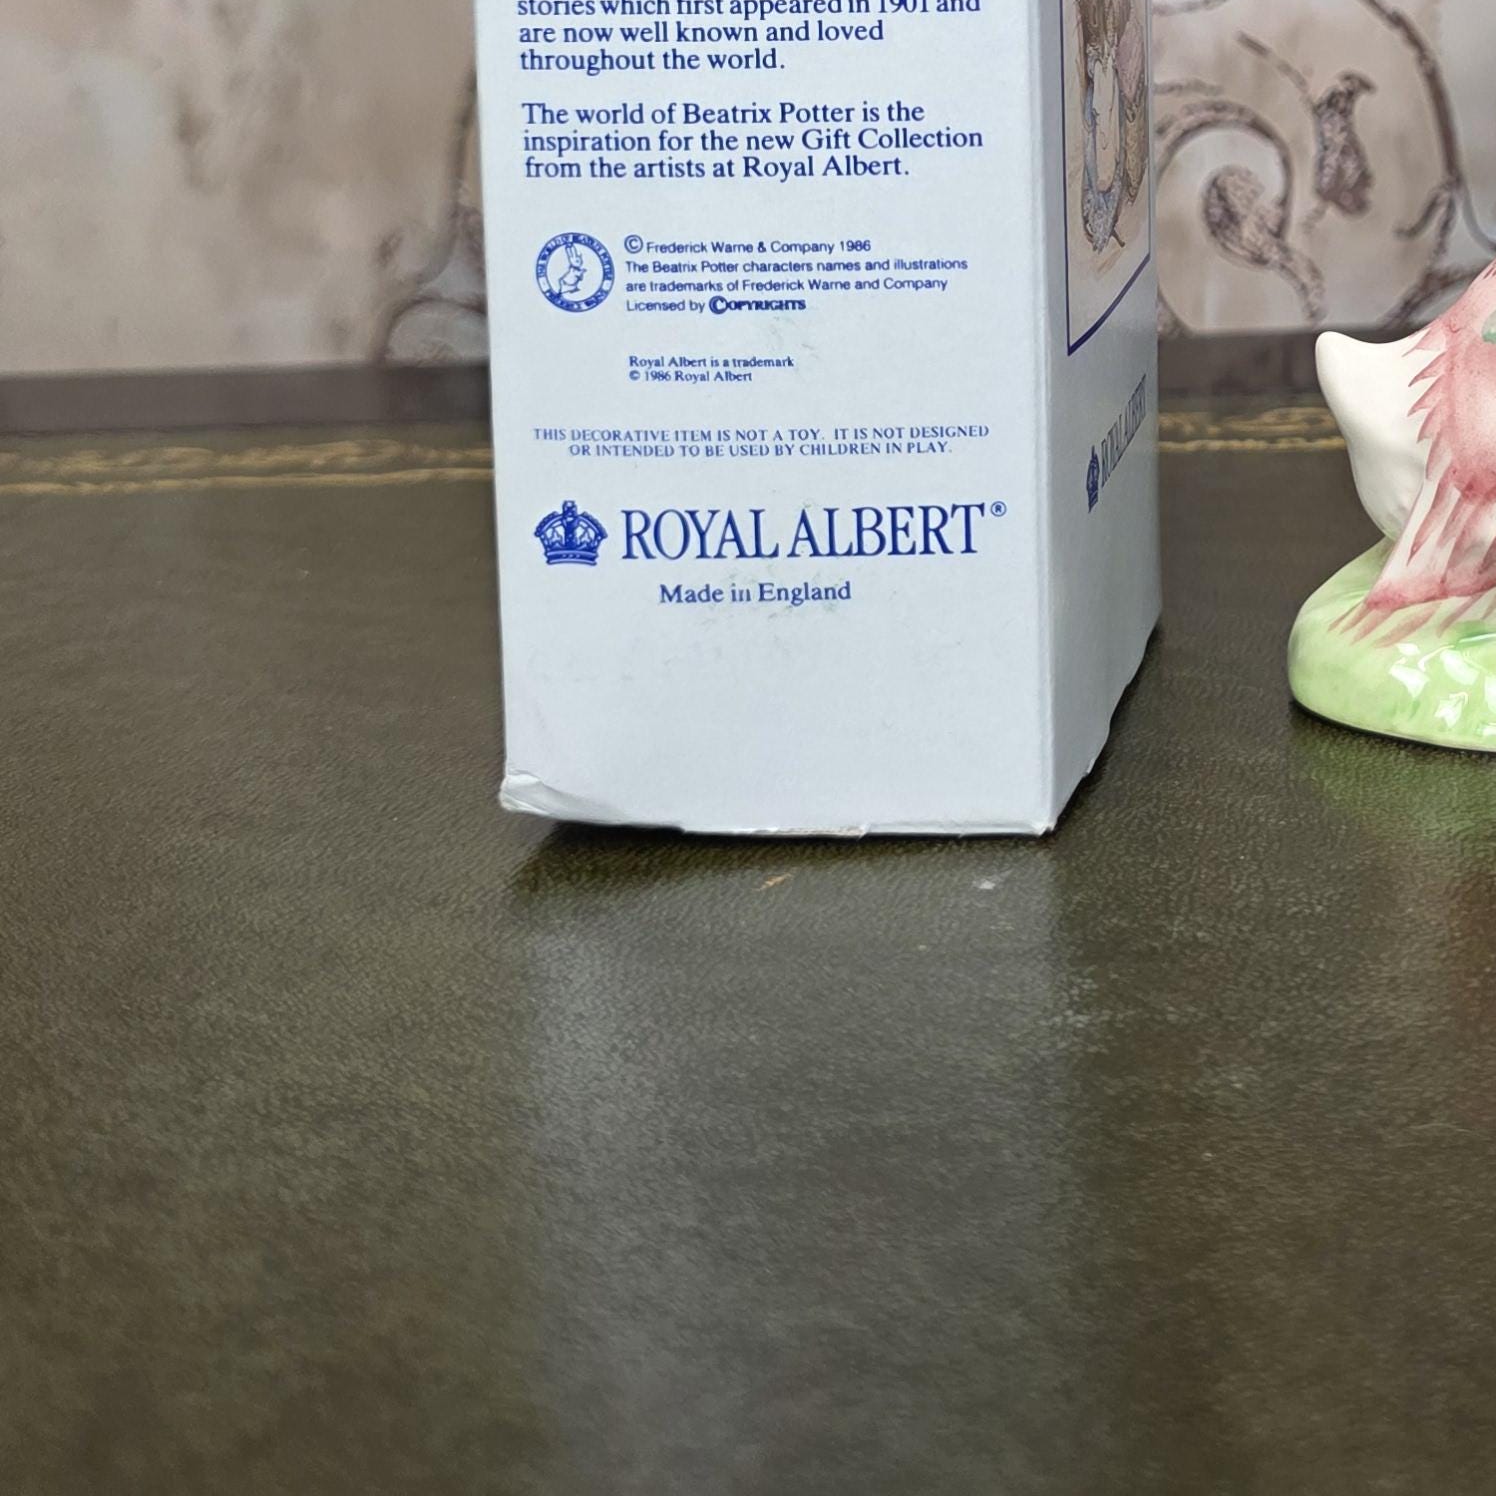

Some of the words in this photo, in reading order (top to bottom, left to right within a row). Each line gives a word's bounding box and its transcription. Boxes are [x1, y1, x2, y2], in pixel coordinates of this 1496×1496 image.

[518, 27, 557, 44] are
[562, 27, 614, 43] now
[618, 20, 670, 43] well
[675, 20, 759, 43] known
[765, 19, 811, 42] and
[816, 18, 885, 42] loved
[519, 47, 656, 77] throughout
[662, 47, 701, 71] the
[706, 47, 786, 70] world.
[520, 102, 570, 125] The
[574, 102, 645, 125] world
[650, 101, 678, 125] of
[681, 101, 773, 125] Beatrix
[778, 101, 856, 124] Potter
[861, 100, 881, 123] is
[886, 99, 926, 123] the
[523, 128, 652, 158] inspiration
[657, 128, 695, 152] for
[700, 128, 740, 152] the
[745, 134, 795, 151] new
[801, 127, 852, 151] Gift
[857, 125, 984, 150] Collection
[524, 155, 583, 179] from
[588, 155, 628, 179] the
[633, 155, 706, 179] artists
[712, 159, 736, 179] at
[741, 154, 815, 184] Royal
[821, 154, 910, 177] Albert.
[645, 240, 708, 254] Frederick
[710, 240, 754, 254] Warne
[756, 240, 768, 254] &
[769, 239, 836, 256] Company
[839, 239, 872, 253] 1986
[624, 260, 650, 274] The
[651, 260, 698, 274] Beatrix
[700, 260, 740, 273] Potter
[742, 260, 814, 273] characters
[816, 261, 862, 273] names
[864, 258, 891, 272] and
[893, 258, 969, 271] illustrations
[625, 282, 647, 293] are
[649, 279, 724, 293] trademarks
[726, 279, 739, 292] of
[741, 278, 805, 292] Frederick
[807, 278, 852, 291] Warne
[853, 278, 881, 291] and
[882, 276, 949, 292] Company
[625, 299, 686, 312] Licensed
[688, 299, 706, 314] by
[533, 428, 567, 441] THIS
[570, 428, 671, 443] DECORATIVE
[674, 429, 712, 443] ITEM
[717, 429, 731, 442] IS
[735, 428, 769, 442] NOT
[772, 429, 784, 442] A
[787, 428, 826, 442] TOY.
[834, 427, 849, 441] IT
[853, 427, 868, 441] IS
[872, 426, 905, 440] NOT
[909, 425, 990, 439] DESIGNED
[567, 444, 592, 457] OR
[595, 444, 675, 458] INTENDED
[679, 444, 701, 458] TO
[704, 444, 725, 458] BE
[728, 444, 770, 458] USED
[774, 443, 795, 457] BY
[799, 442, 881, 457] CHILDREN
[885, 441, 903, 455] IN
[906, 440, 952, 454] PLAY.
[620, 508, 780, 561] ROYAL
[659, 583, 725, 604] Made
[730, 582, 752, 603] in
[757, 580, 852, 608] England
